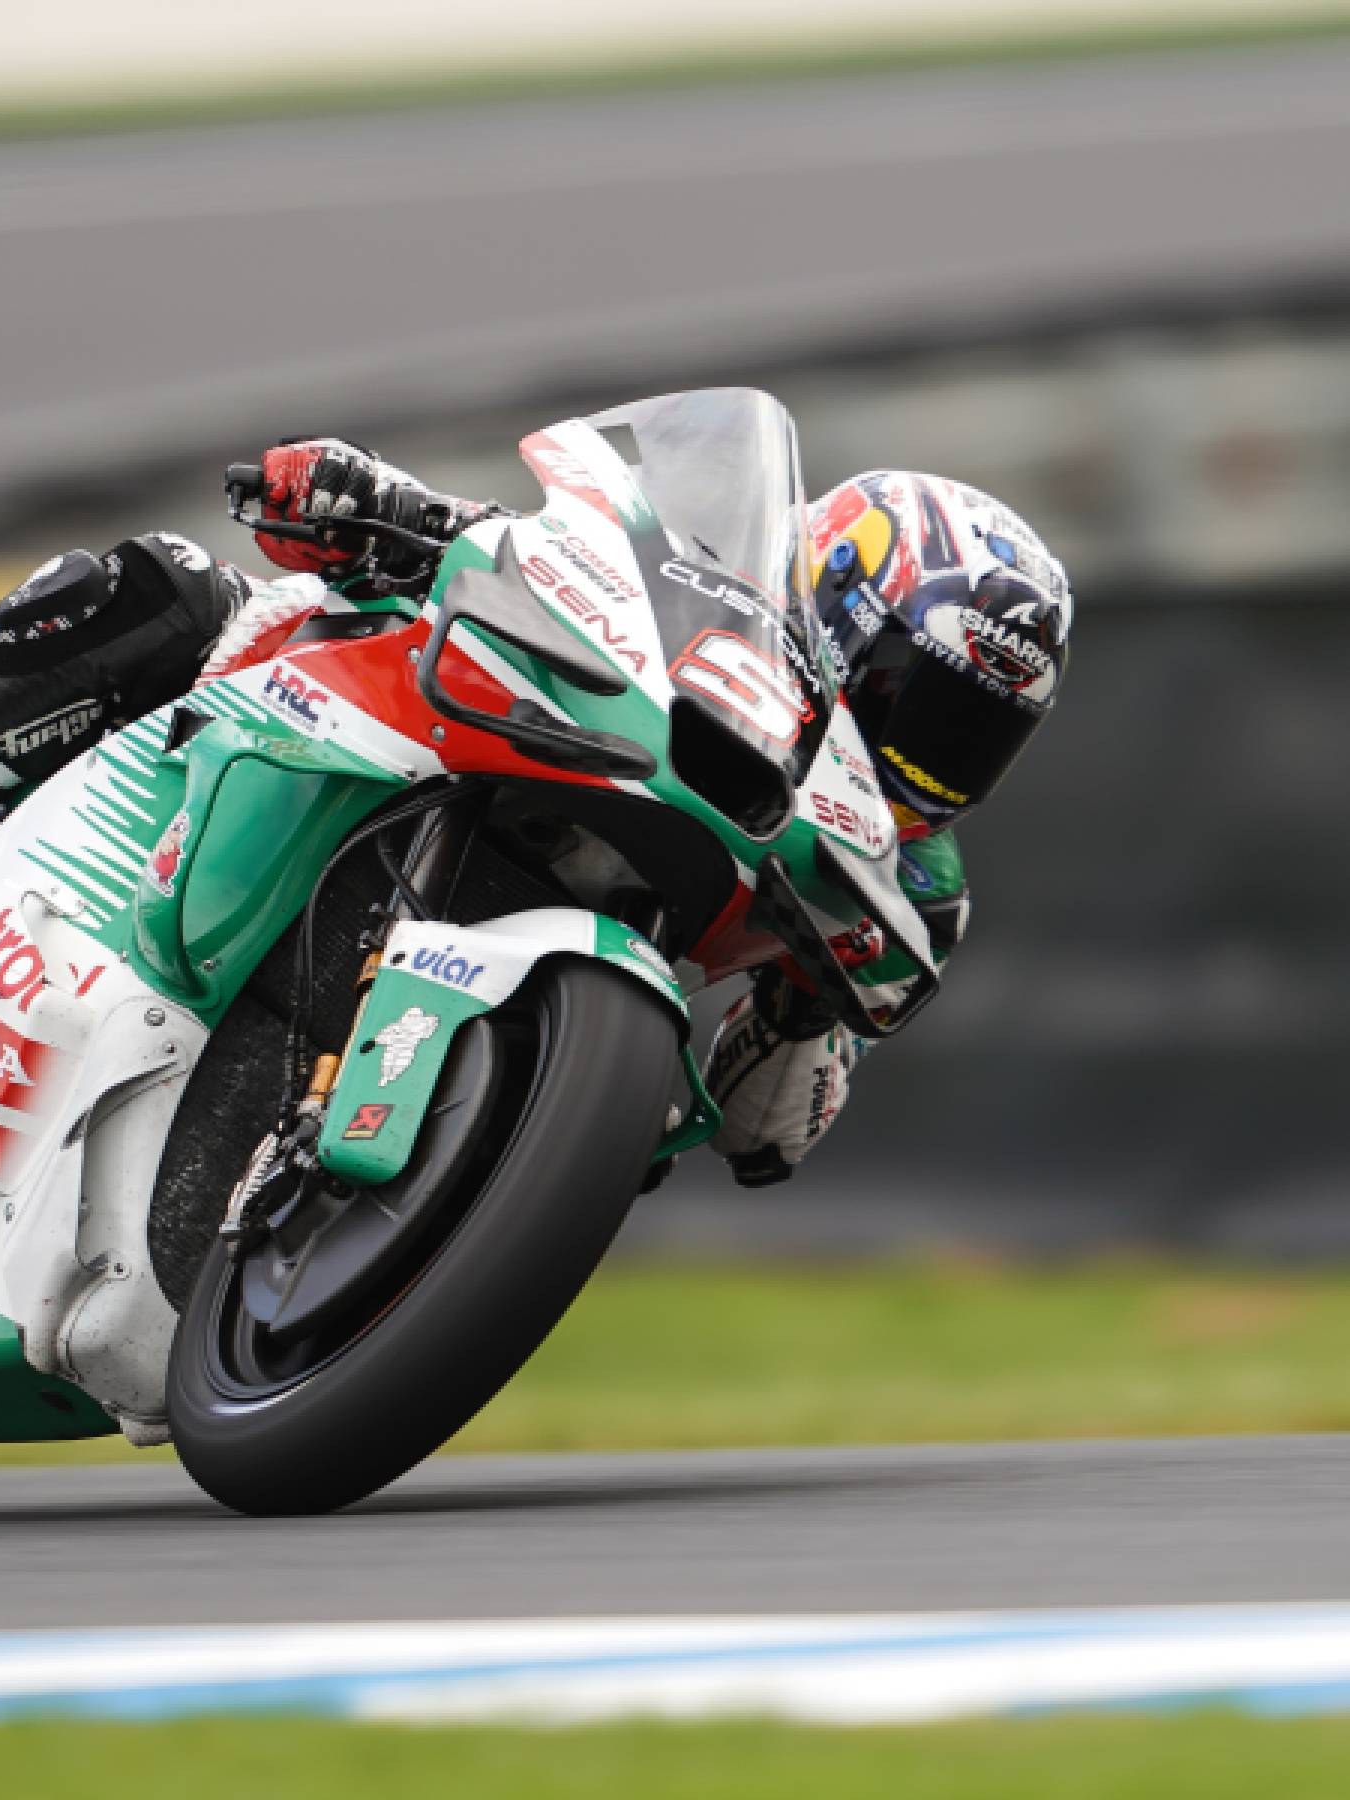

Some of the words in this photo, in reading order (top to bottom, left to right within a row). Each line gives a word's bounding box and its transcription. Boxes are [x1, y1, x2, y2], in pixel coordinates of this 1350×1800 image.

[519, 555, 649, 675] SENA
[958, 606, 1054, 671] SHARK
[263, 665, 329, 723] HRC
[666, 627, 816, 750] 5
[809, 791, 883, 847] SENA
[412, 945, 485, 988] viar
